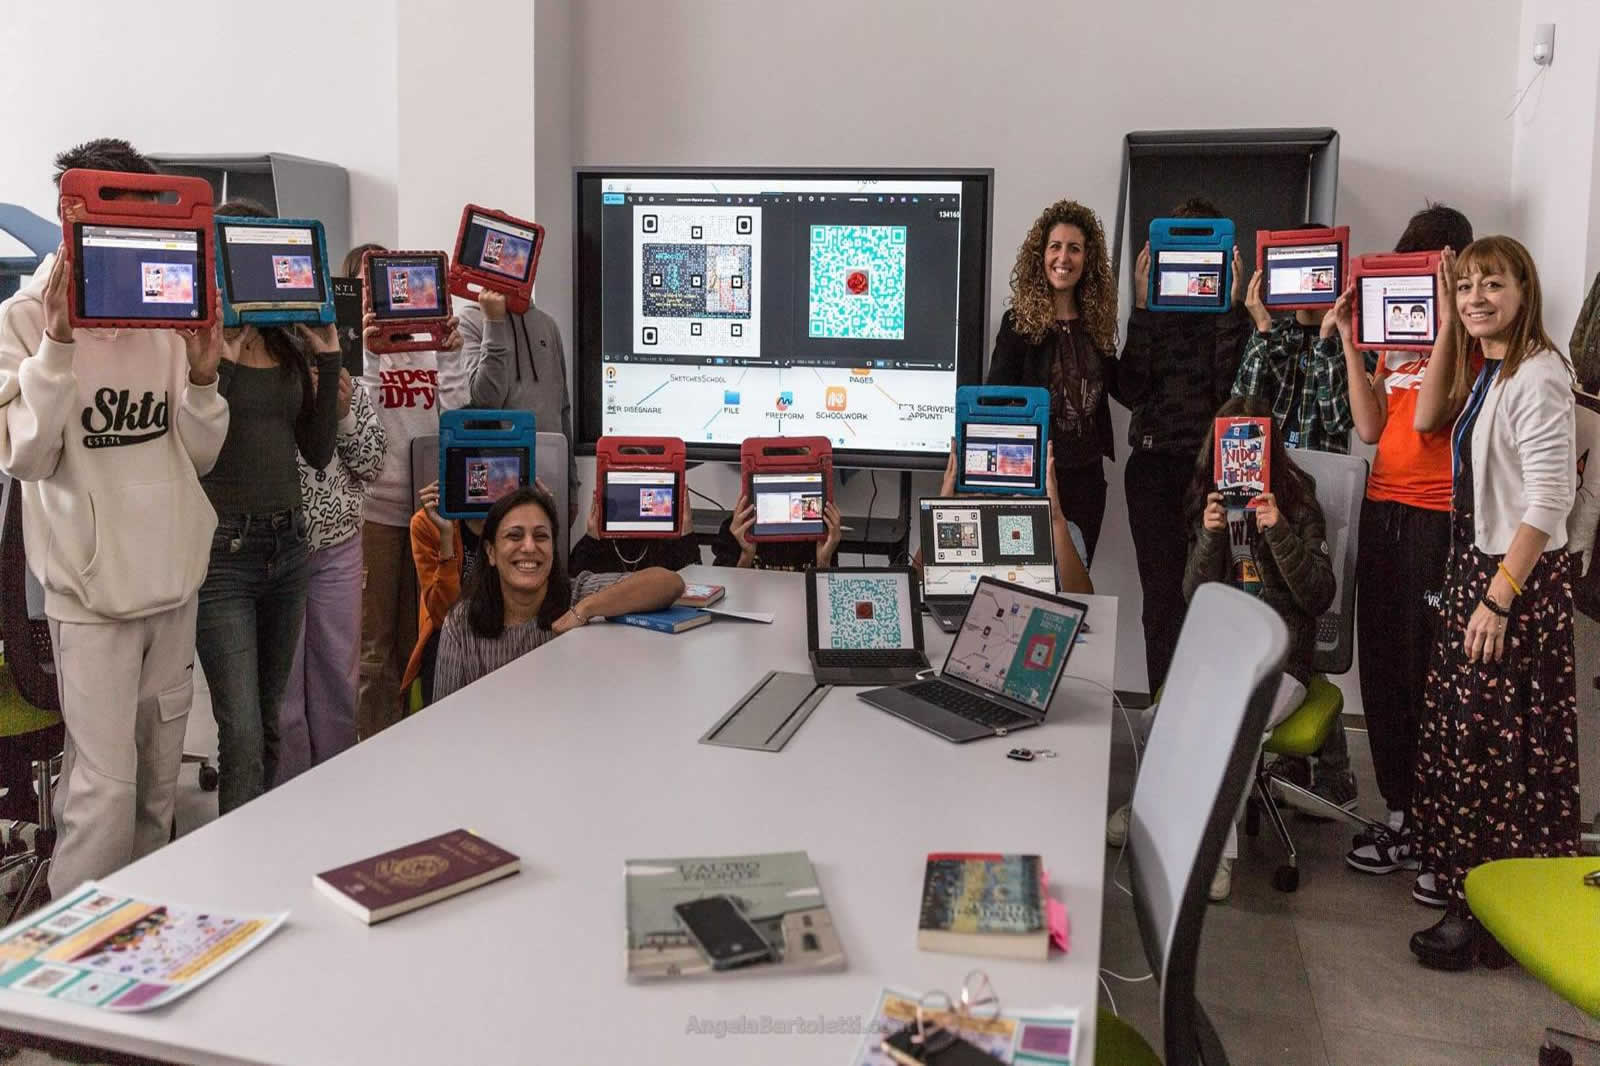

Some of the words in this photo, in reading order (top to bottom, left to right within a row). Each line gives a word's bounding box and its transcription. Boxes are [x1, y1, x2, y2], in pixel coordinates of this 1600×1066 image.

[849, 376, 874, 384] PAGES
[380, 385, 435, 410] Dry
[623, 406, 662, 414] DISEGNARE
[765, 411, 805, 420] FREEFORM
[815, 411, 868, 420] SCHOOLWORK
[909, 411, 943, 420] APPUNTI
[1225, 448, 1257, 465] NIDO
[1224, 467, 1264, 484] TEMPO
